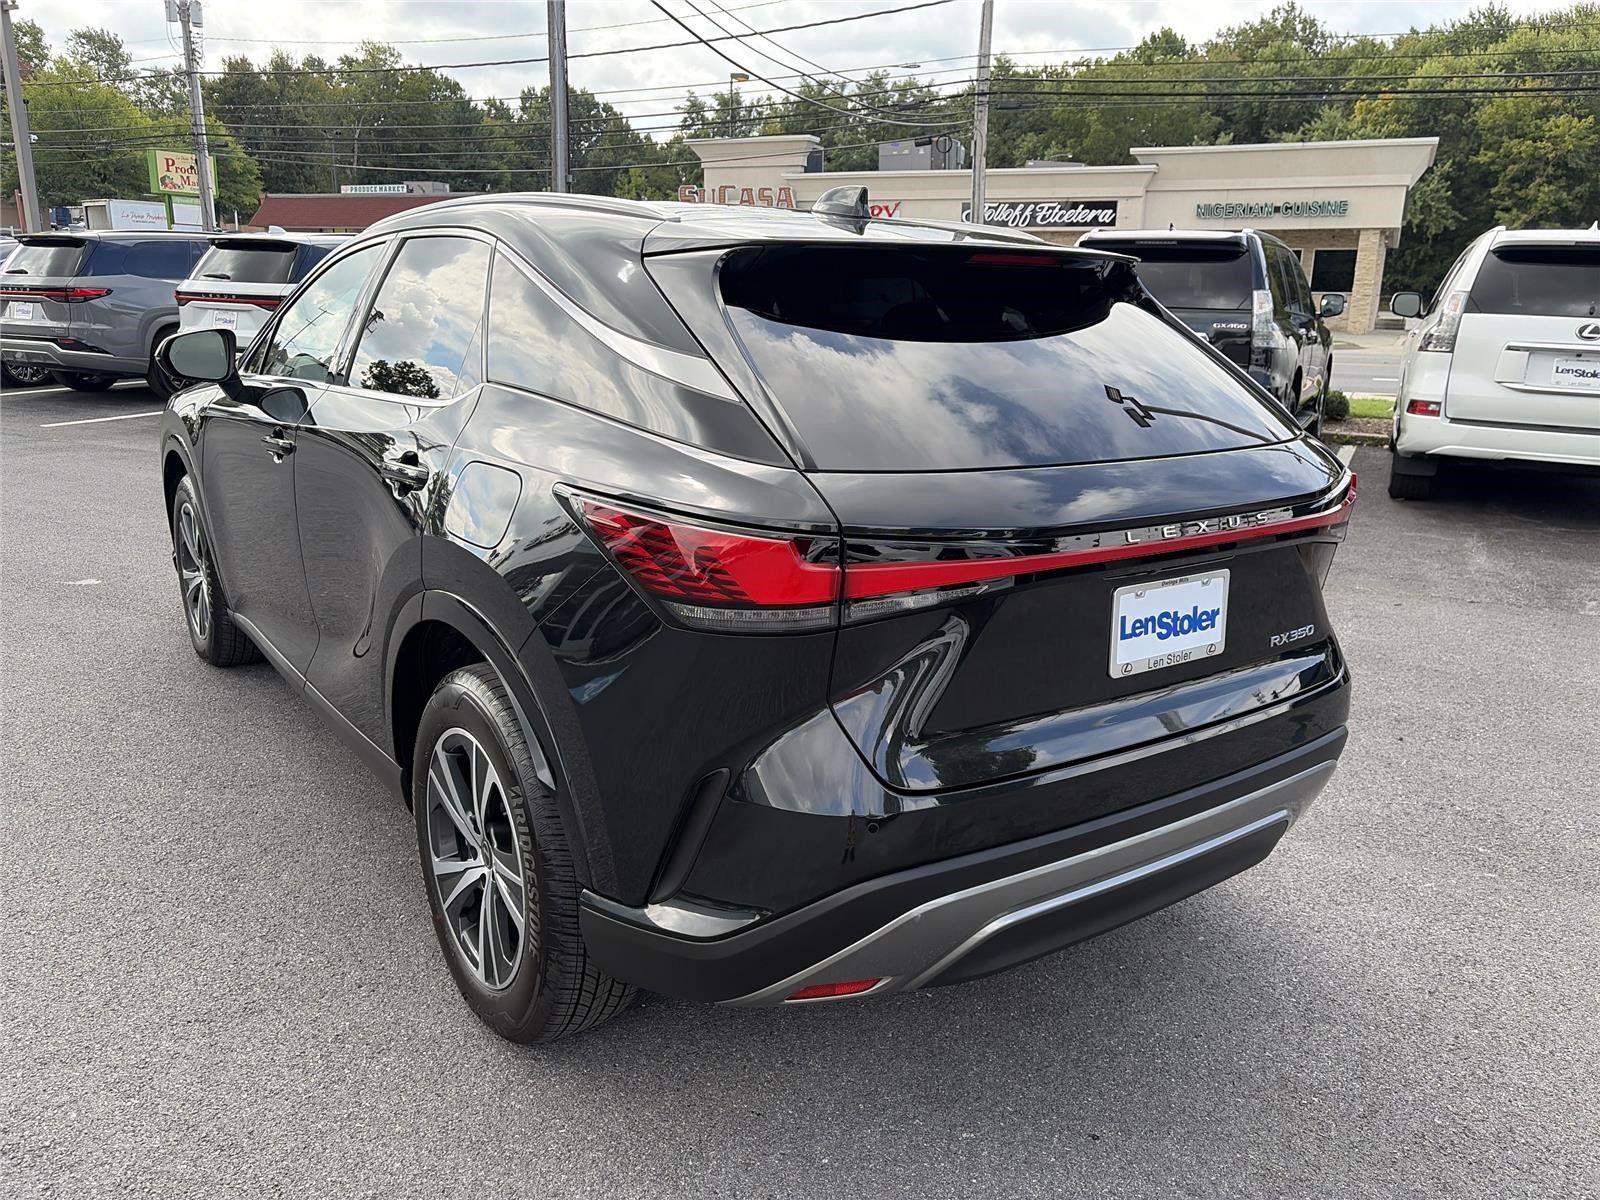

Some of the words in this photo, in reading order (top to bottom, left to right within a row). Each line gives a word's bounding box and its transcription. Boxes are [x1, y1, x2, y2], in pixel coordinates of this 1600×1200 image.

[350, 185, 377, 193] PRODUCE
[379, 185, 405, 193] MARKET
[1035, 202, 1115, 225] Etcetera
[1196, 203, 1274, 217] NIGERIAN
[1281, 200, 1348, 216] CUISINE
[1125, 512, 1268, 544] LEXUS
[1120, 606, 1220, 641] LenStoler
[1147, 658, 1164, 670] Len
[1166, 650, 1192, 665] Stoler
